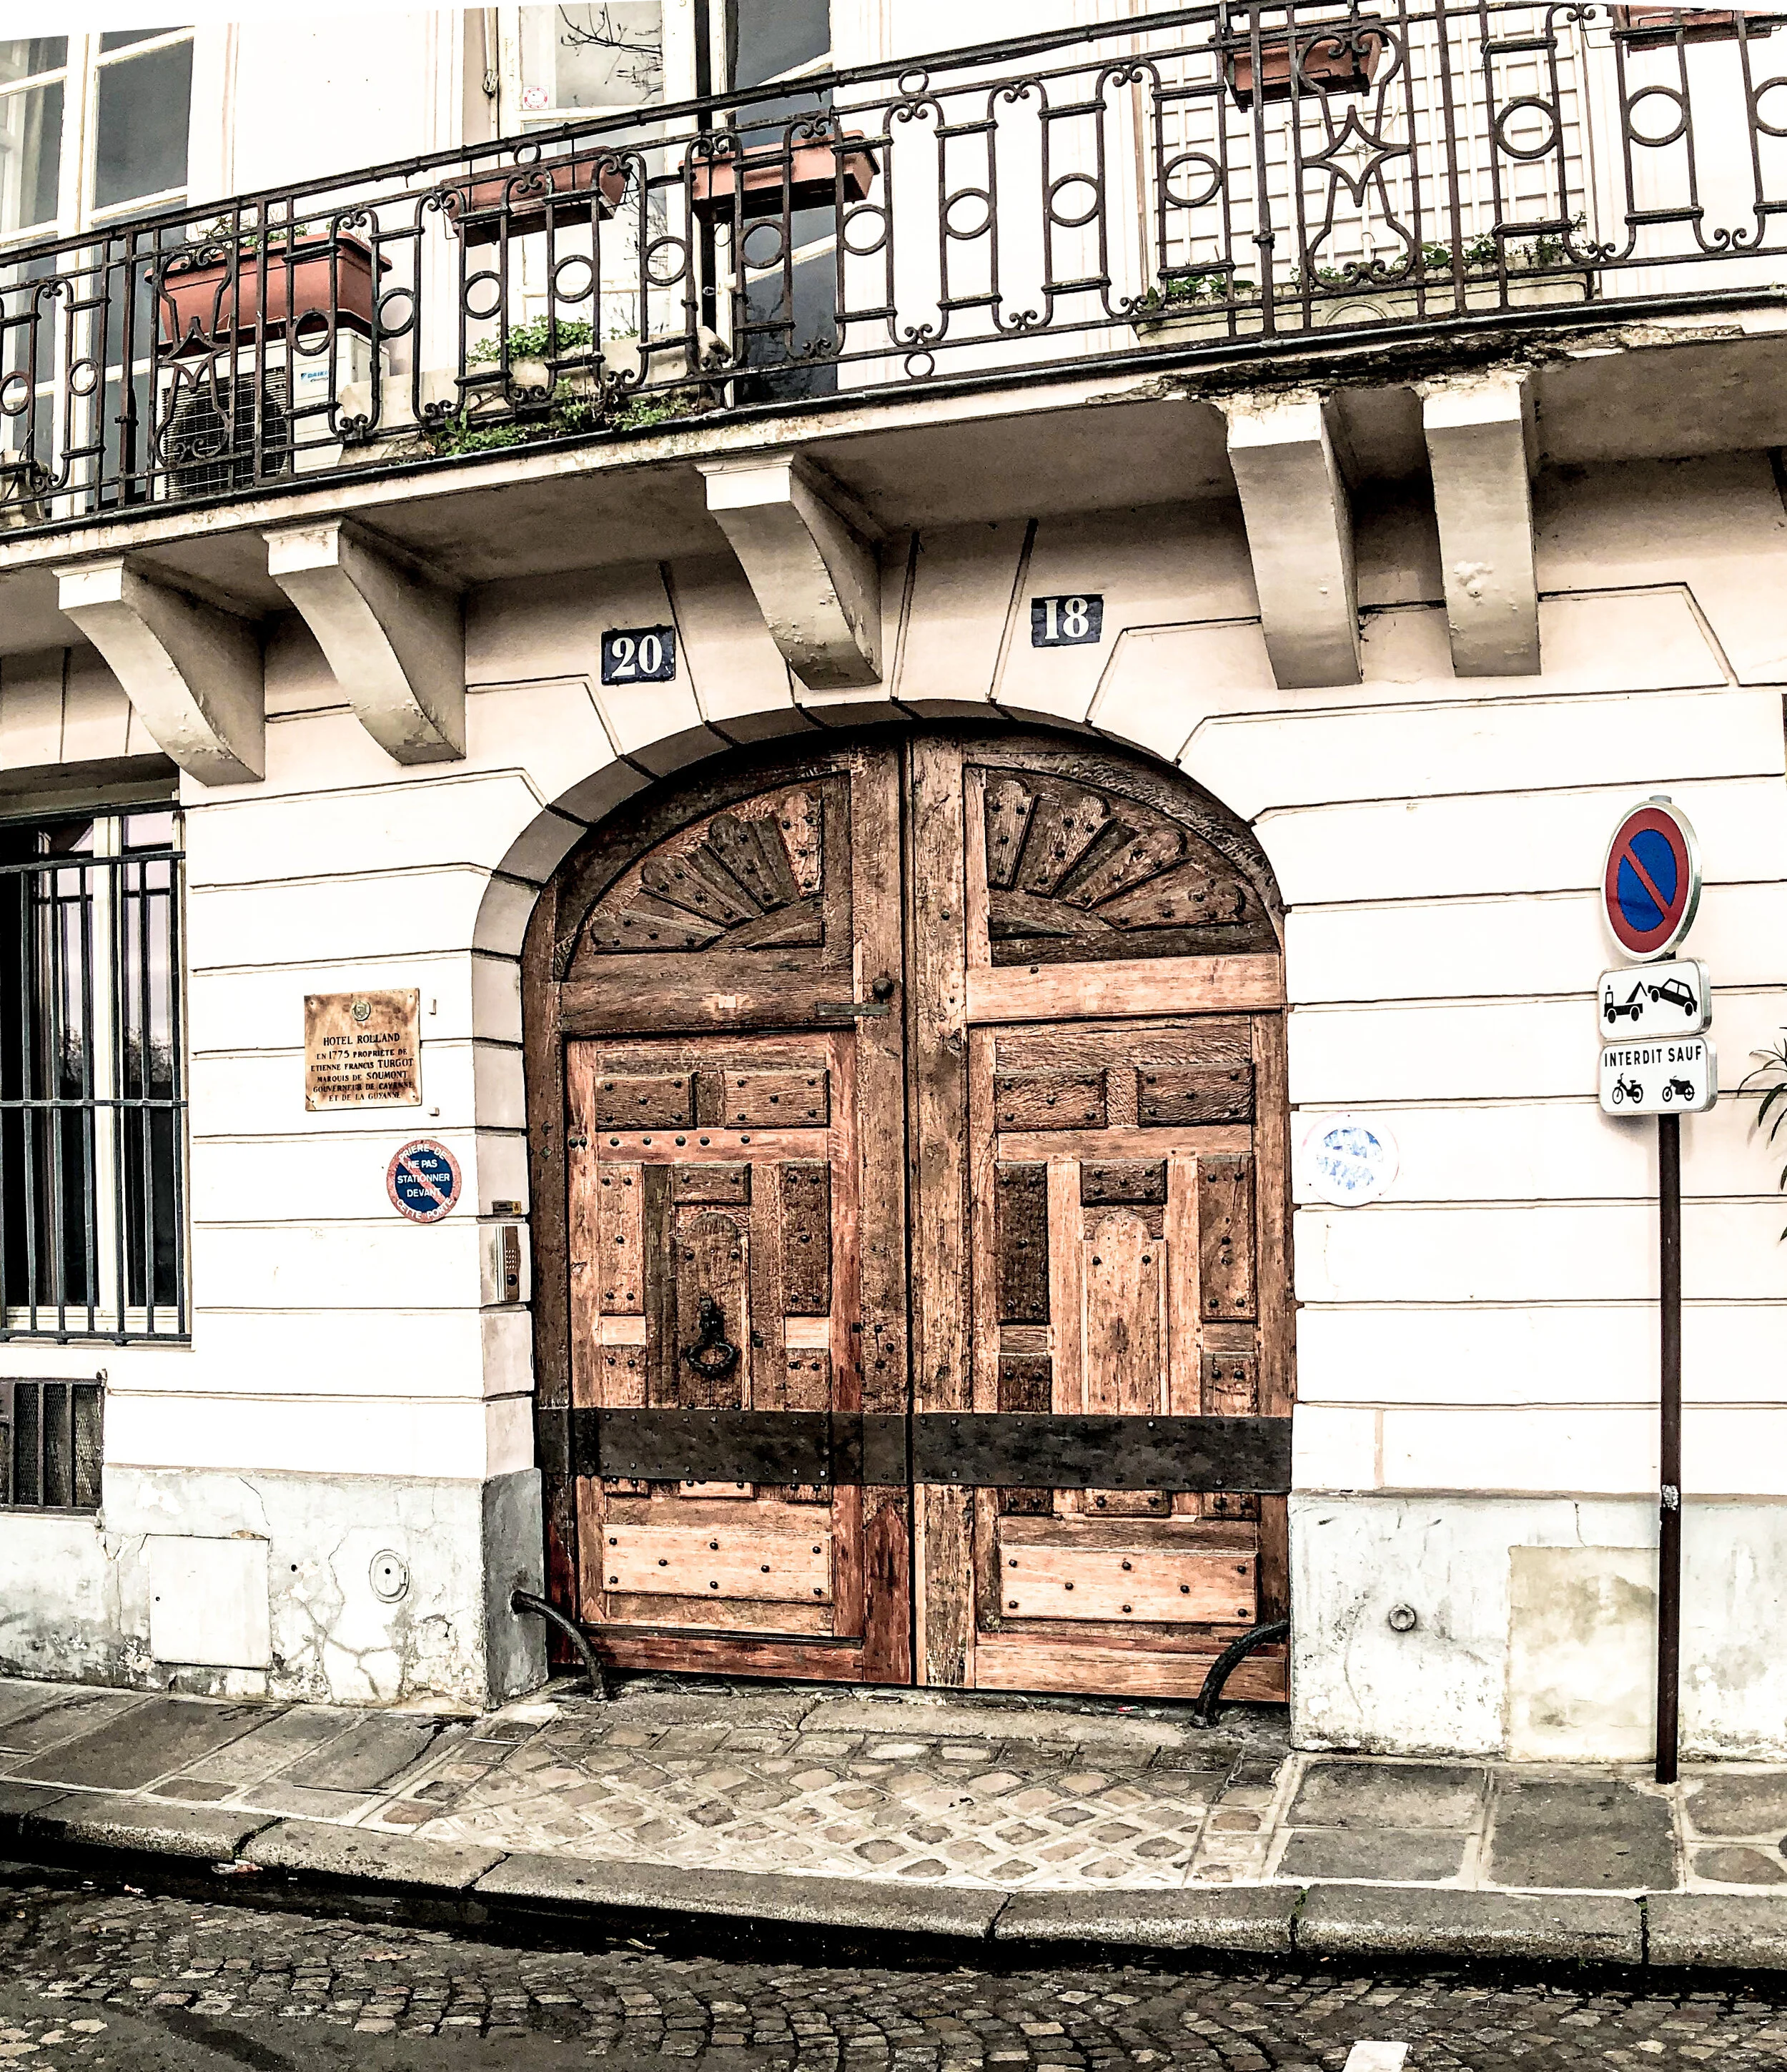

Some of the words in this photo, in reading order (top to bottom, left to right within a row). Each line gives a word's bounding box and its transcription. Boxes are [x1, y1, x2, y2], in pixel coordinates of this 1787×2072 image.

[1044, 598, 1089, 639] 18
[611, 635, 663, 678] 20
[323, 1036, 353, 1046] HOTEL
[357, 1033, 400, 1044] ROLLAND
[329, 1050, 350, 1061] 1775
[1604, 1049, 1662, 1067] INTERDIT
[1668, 1045, 1702, 1062] SAUF
[377, 1058, 414, 1069] TURGOT
[366, 1071, 408, 1080] SOUMONT
[313, 1084, 362, 1093] GOUVERNEUR
[379, 1081, 414, 1090] CAYENNE
[397, 1144, 430, 1161] PRIERE
[433, 1146, 447, 1160] DE
[407, 1160, 420, 1169] NE
[421, 1159, 438, 1169] PAS
[397, 1173, 450, 1184] STATIONNER
[407, 1187, 442, 1198] DEVANT
[396, 1199, 422, 1219] CETTE
[426, 1196, 454, 1219] PORTE
